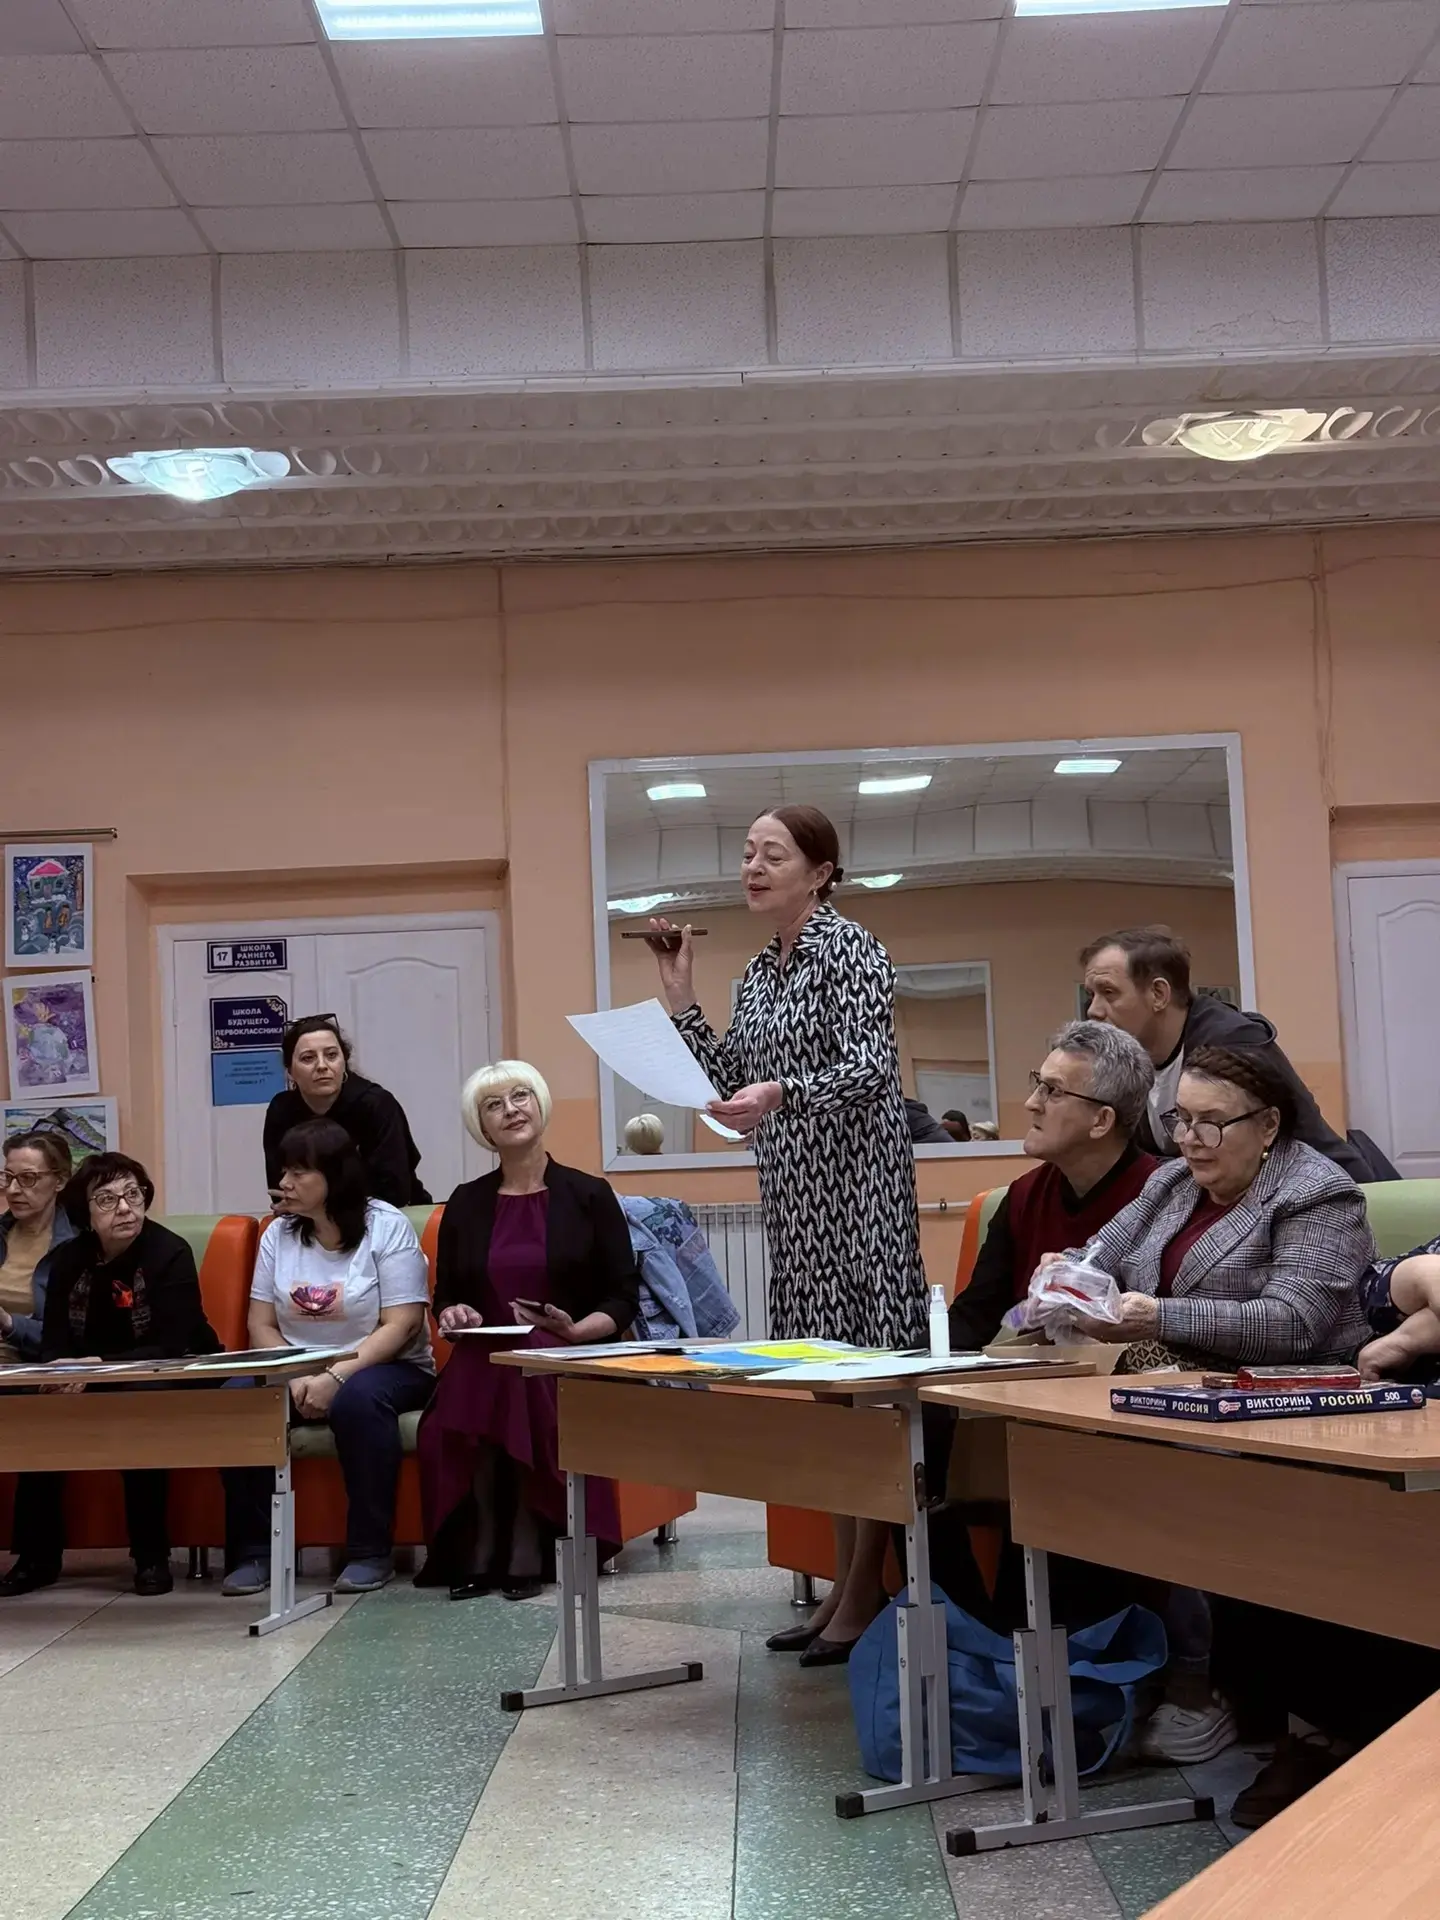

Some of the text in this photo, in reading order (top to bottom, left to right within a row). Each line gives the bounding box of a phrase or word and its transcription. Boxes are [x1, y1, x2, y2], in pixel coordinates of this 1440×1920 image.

[240, 944, 271, 952] ШКОЛА
[216, 951, 228, 962] 17
[237, 951, 275, 959] РАННЕГО
[235, 959, 278, 967] РАЗВИТИЯ
[232, 1008, 262, 1016] ШКОЛА
[228, 1018, 270, 1026] БУДУЩЕГО
[215, 1027, 283, 1036] ПЕРВОКЛАССНИКА
[1384, 1391, 1400, 1401] 500
[1130, 1396, 1166, 1406] ВИКТОРИНА
[1172, 1401, 1208, 1413] РОССИЯ
[1246, 1395, 1313, 1409] ВИКТОРИНА
[1320, 1394, 1372, 1406] РОССИЯ
